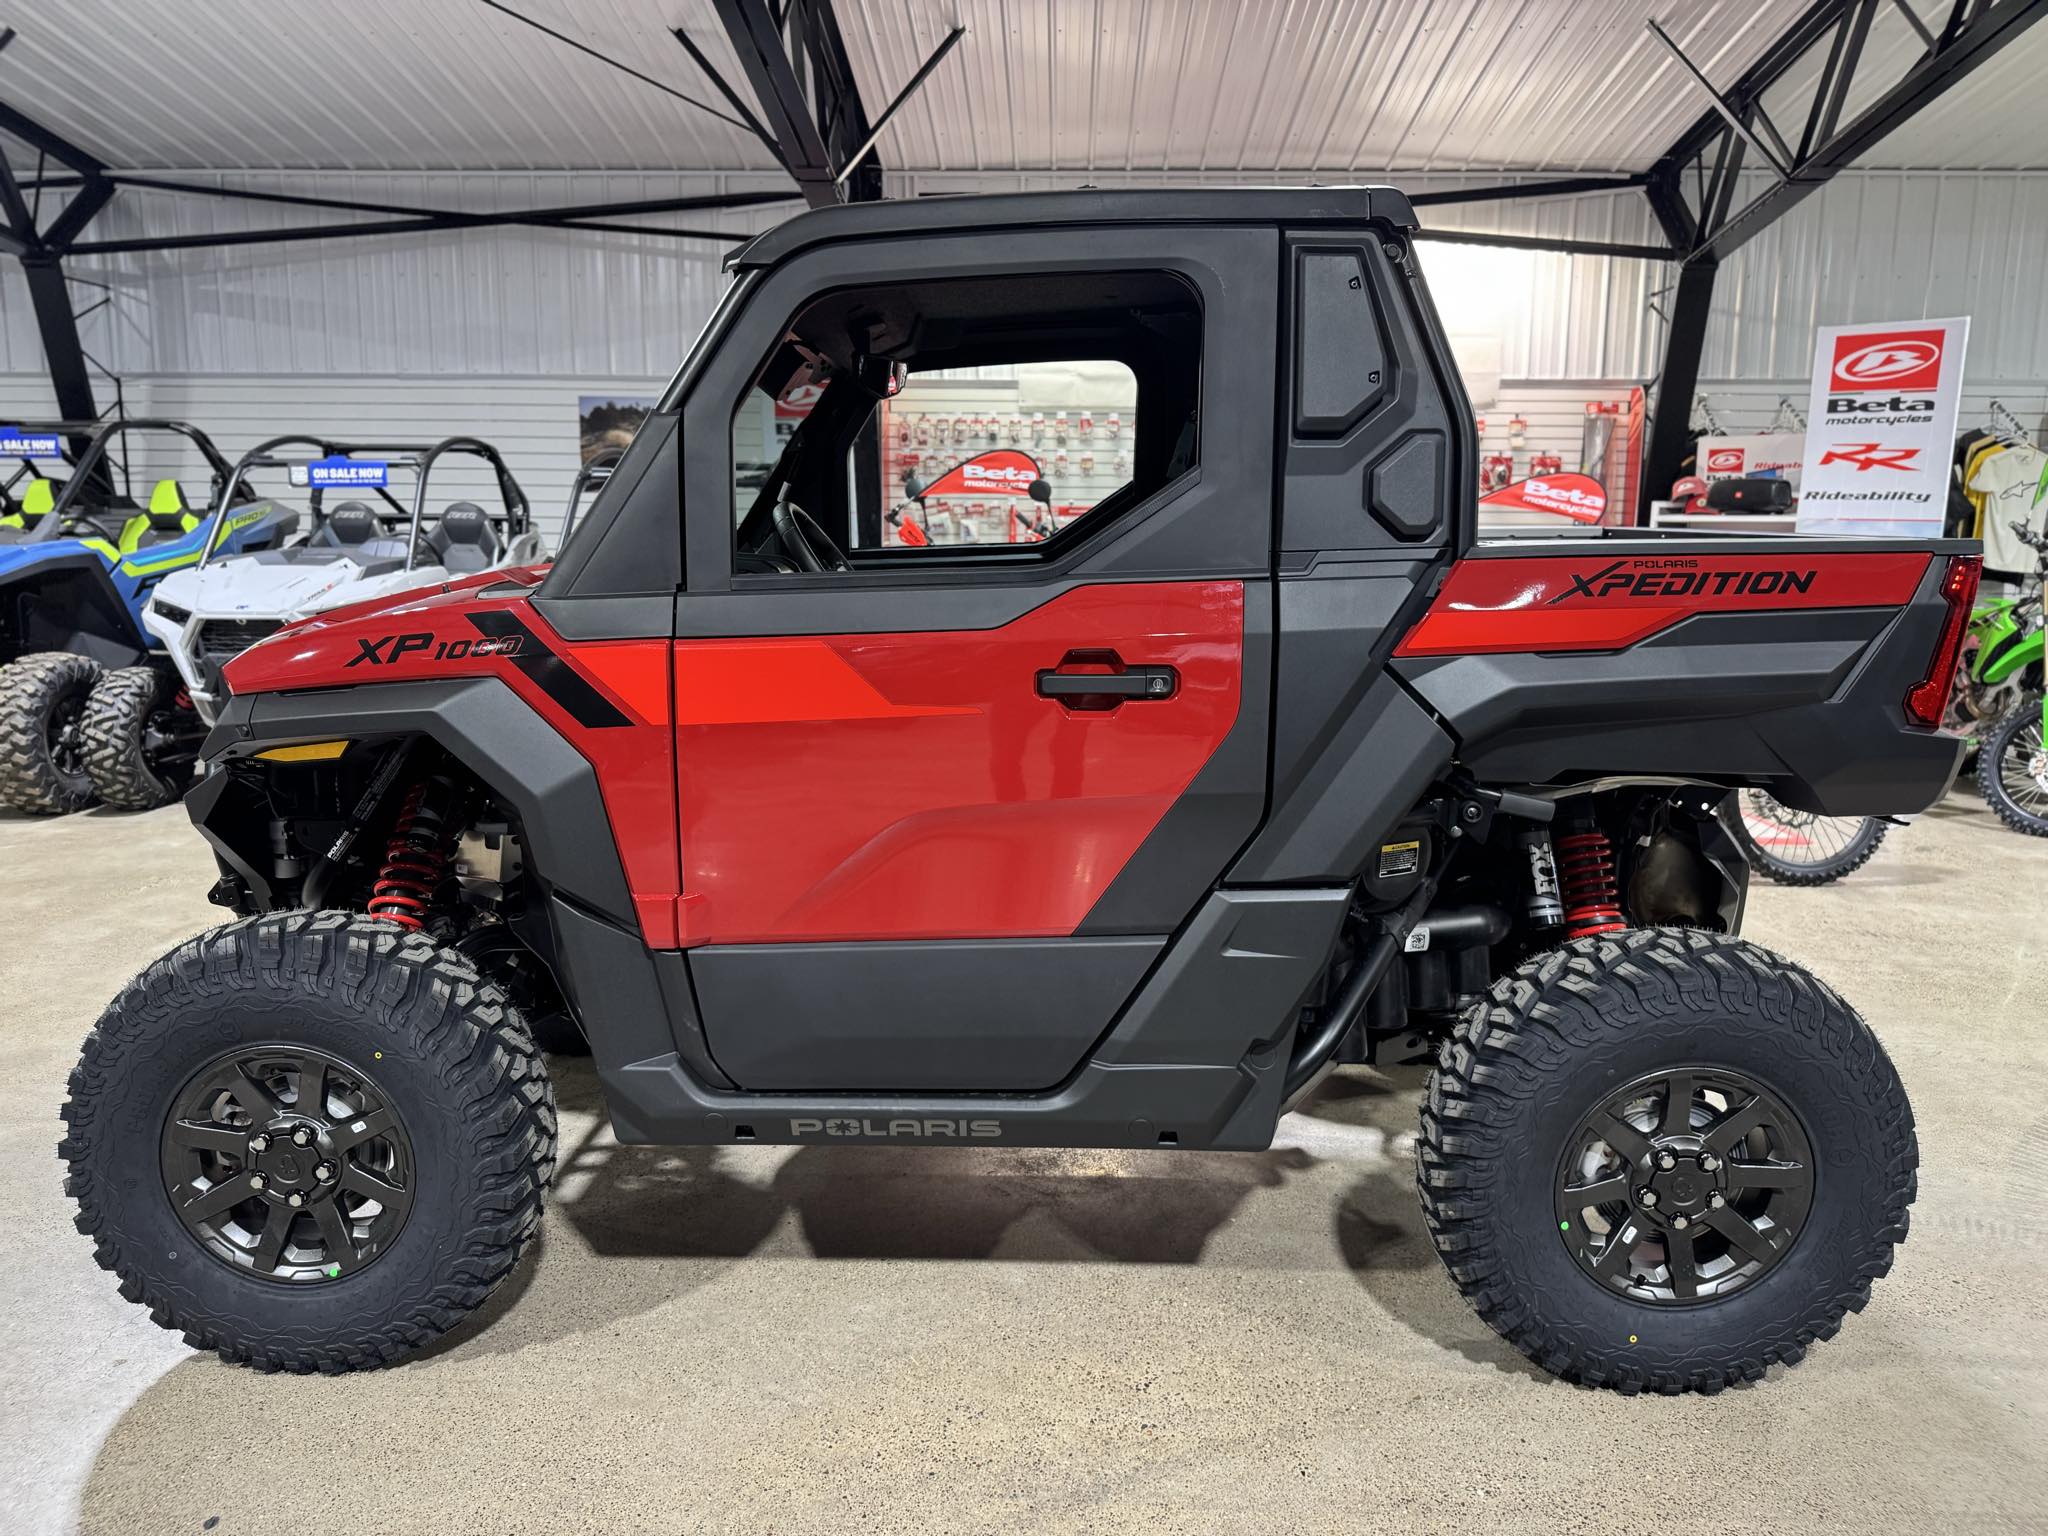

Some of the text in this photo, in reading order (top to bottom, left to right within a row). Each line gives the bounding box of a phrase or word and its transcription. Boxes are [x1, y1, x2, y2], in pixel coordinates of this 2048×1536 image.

[1827, 397, 1935, 415] Beta
[1825, 414, 1934, 426] motorcycles
[3, 439, 56, 450] SALE NOW
[312, 468, 328, 479] ON
[330, 468, 357, 479] SALE
[359, 468, 384, 479] NOW
[963, 464, 1037, 481] Beta
[963, 479, 1029, 490] motorcycle
[1524, 480, 1603, 508] Beta
[1803, 491, 1932, 504] Rideability
[1522, 496, 1601, 517] motorcycles
[1633, 560, 1699, 569] POLARIS
[1544, 561, 1819, 606] XPEDITION
[343, 632, 524, 668] XP 1000
[1528, 842, 1557, 895] FOX
[790, 1118, 1002, 1137] POLARIS
